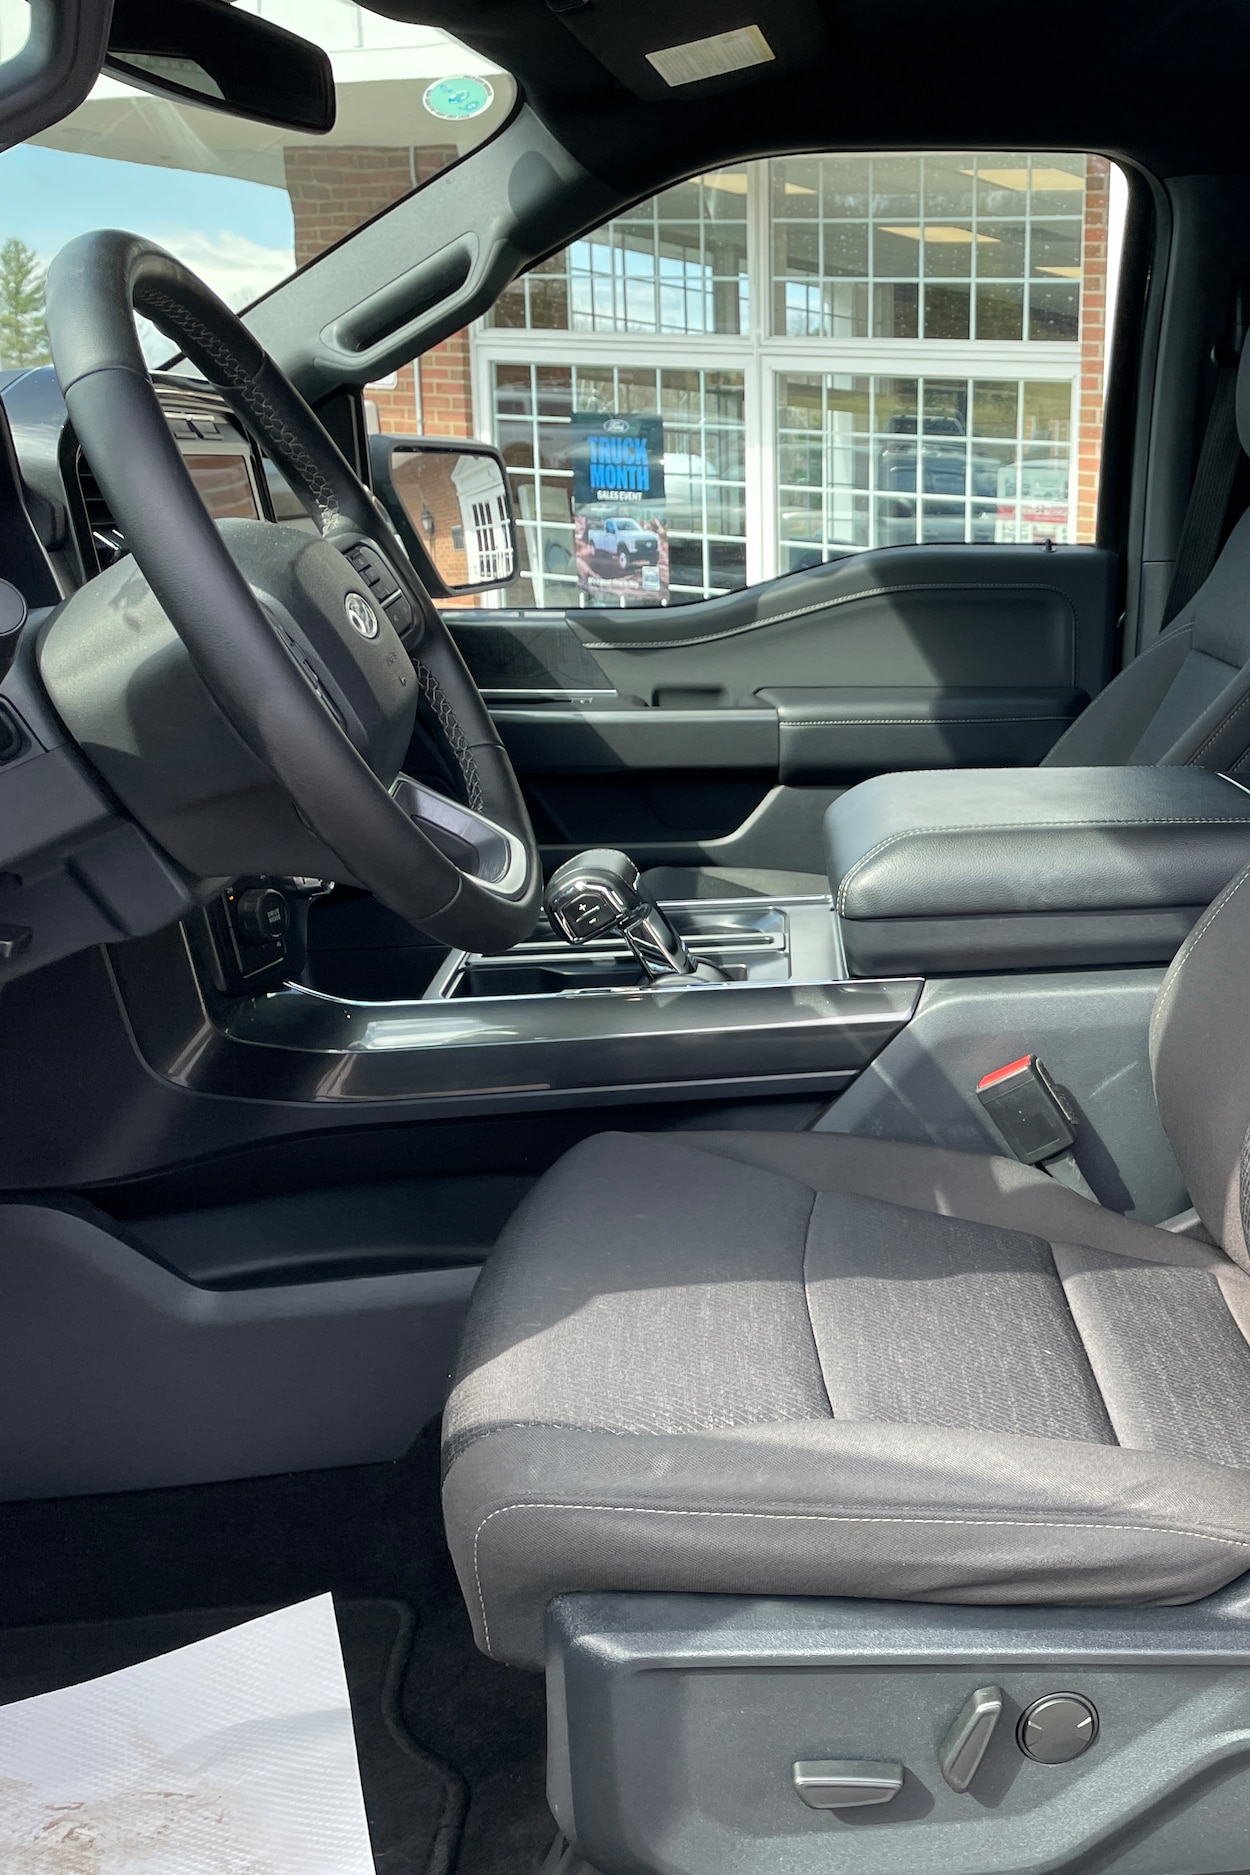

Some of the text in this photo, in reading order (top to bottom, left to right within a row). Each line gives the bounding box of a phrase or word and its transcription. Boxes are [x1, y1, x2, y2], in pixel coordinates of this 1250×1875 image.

[587, 436, 649, 465] TRUCK
[589, 464, 650, 491] MONTH
[596, 490, 643, 502] SALES EVENT
